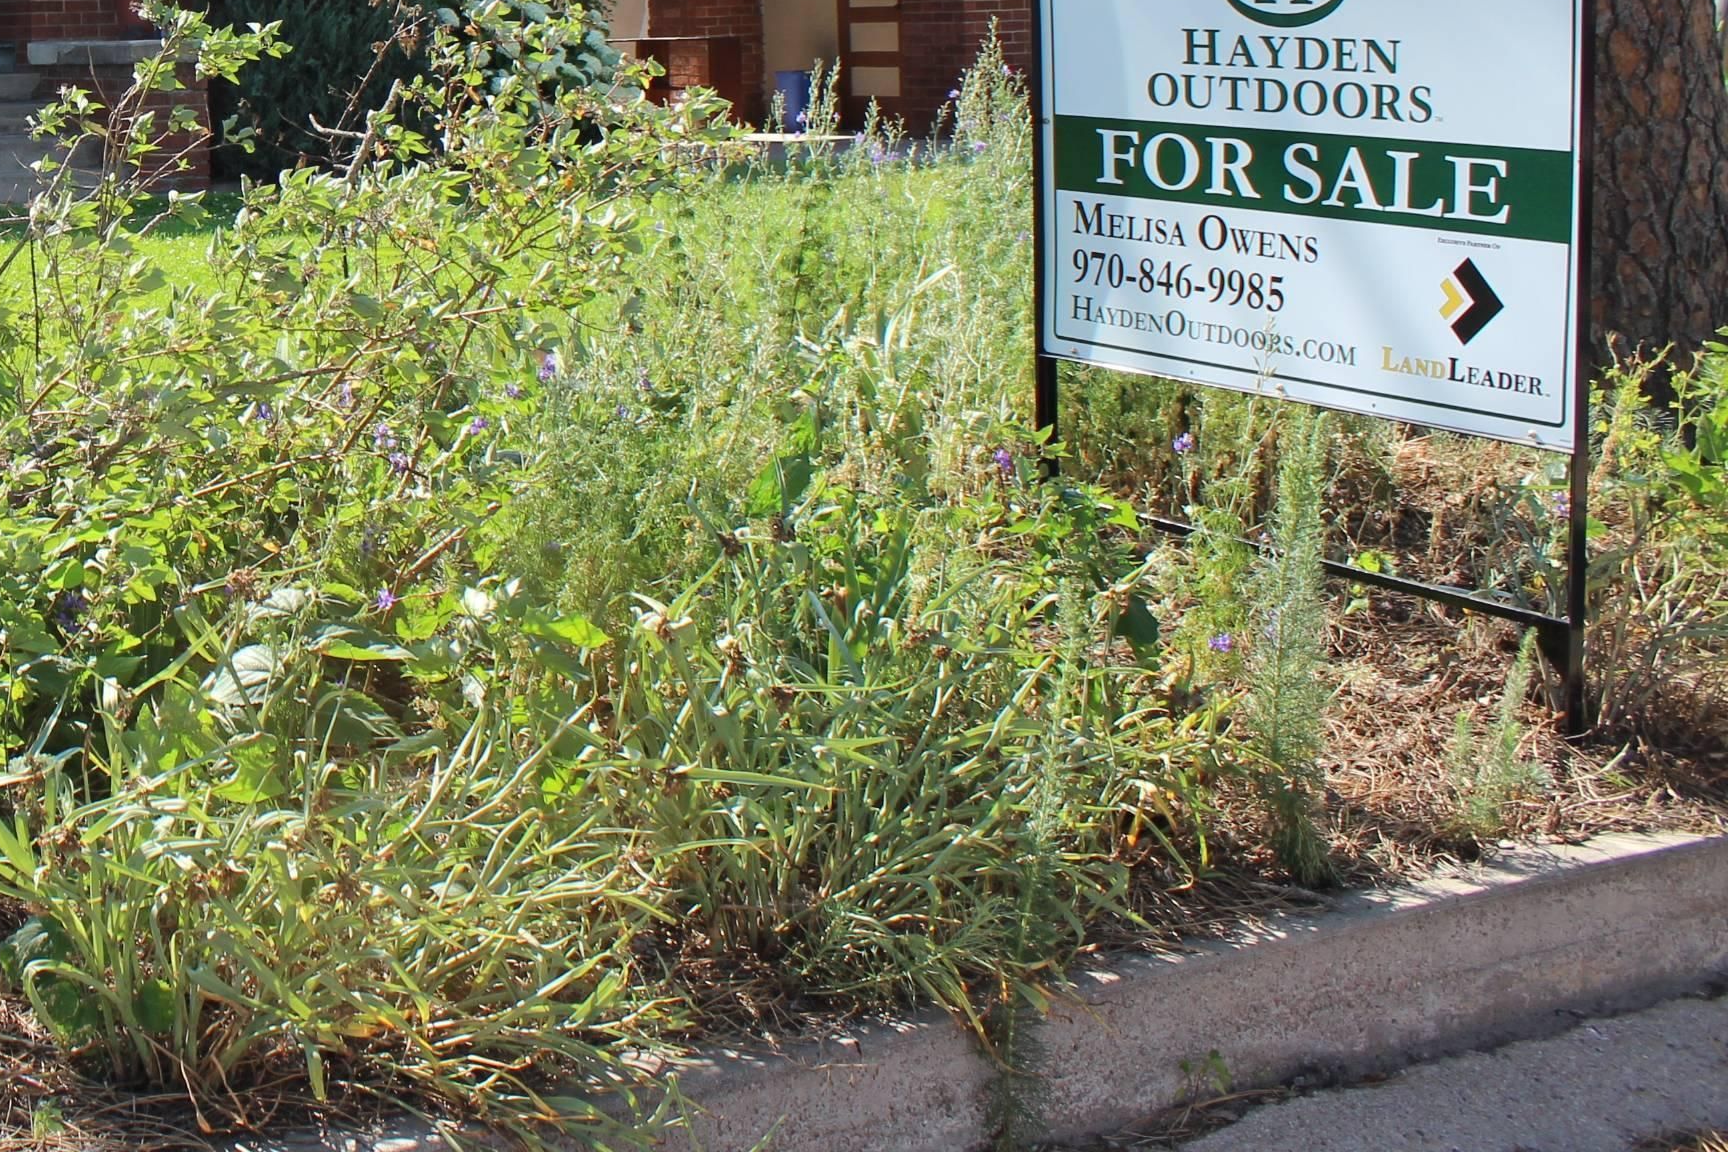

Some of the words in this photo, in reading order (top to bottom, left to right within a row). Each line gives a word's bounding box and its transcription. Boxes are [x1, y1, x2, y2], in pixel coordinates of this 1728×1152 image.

[1181, 28, 1402, 75] HAYDEN
[1147, 71, 1433, 124] OUTDOORS
[1095, 127, 1261, 199] FOR
[1282, 141, 1512, 225] SALE
[1072, 248, 1285, 313] 970-846-9985
